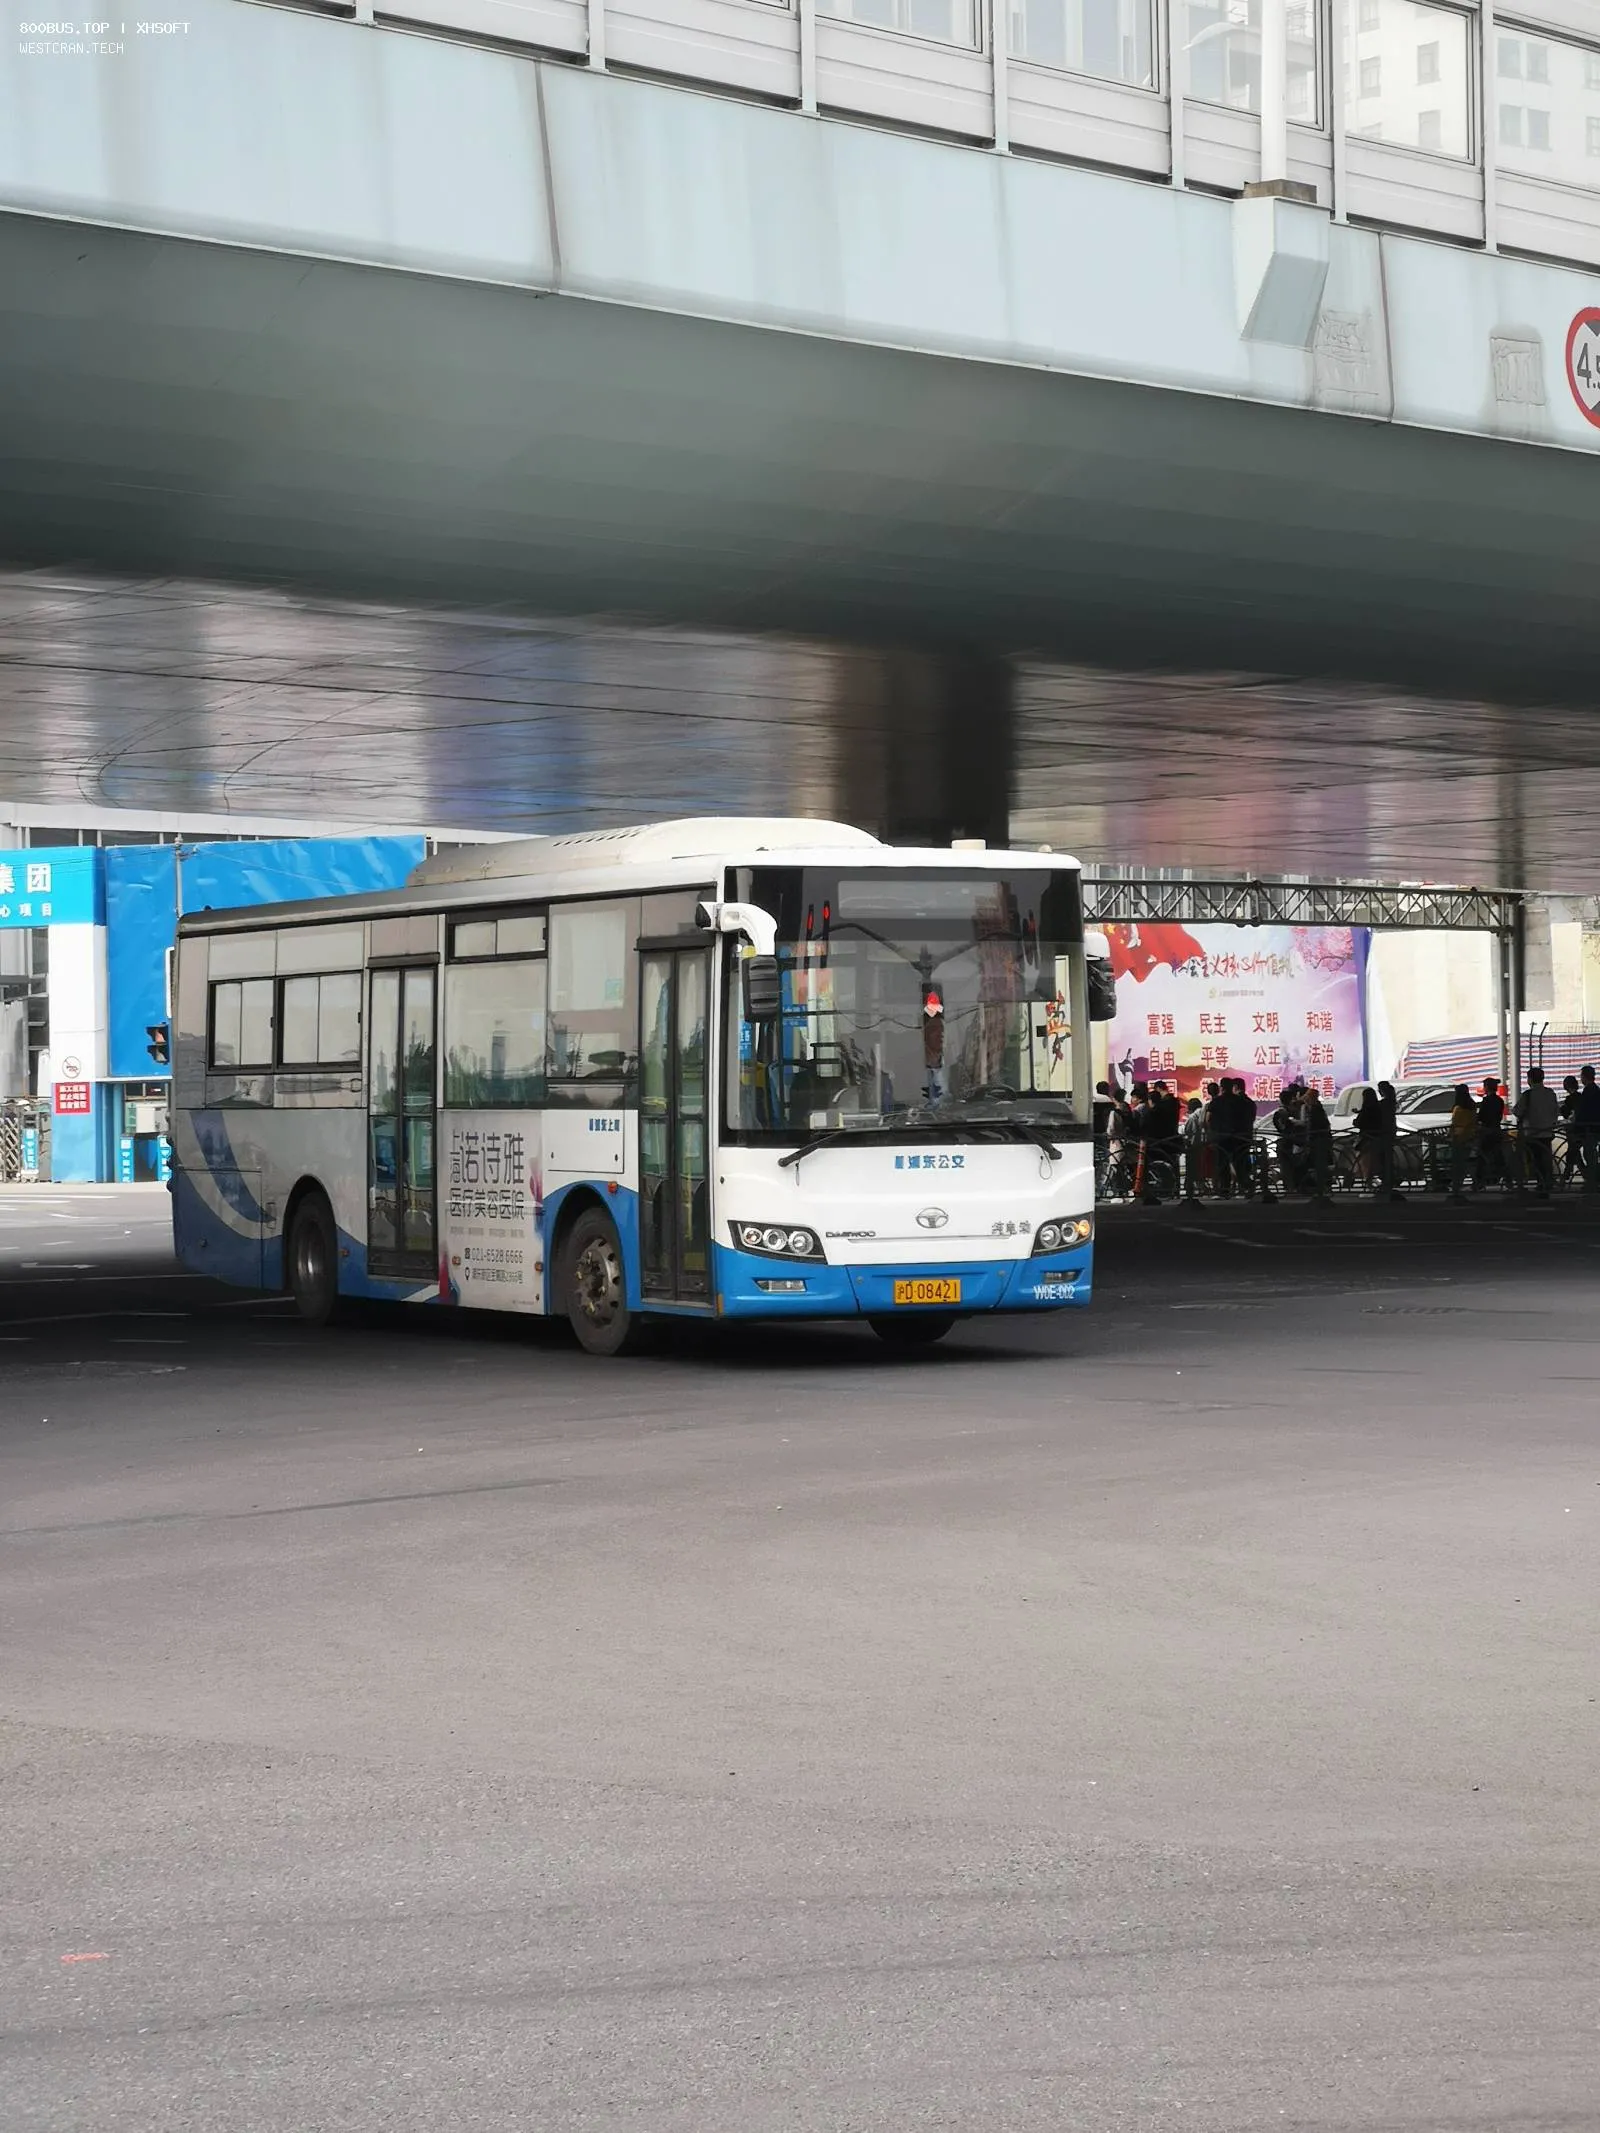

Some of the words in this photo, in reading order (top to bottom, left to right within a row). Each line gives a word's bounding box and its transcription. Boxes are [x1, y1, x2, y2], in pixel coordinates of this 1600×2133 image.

[1577, 342, 1600, 389] 4.
[1147, 1014, 1176, 1035] 富强
[1200, 1013, 1227, 1034] 民主
[1252, 1012, 1279, 1033] 文明
[1307, 1011, 1333, 1032] 和谐
[1149, 1048, 1175, 1071] 自由
[1201, 1046, 1229, 1068] 平等
[1254, 1045, 1281, 1065] 公正
[1308, 1044, 1334, 1064] 法治
[1255, 1077, 1283, 1100] 诚信
[450, 1187, 524, 1219] 医疗美容医院
